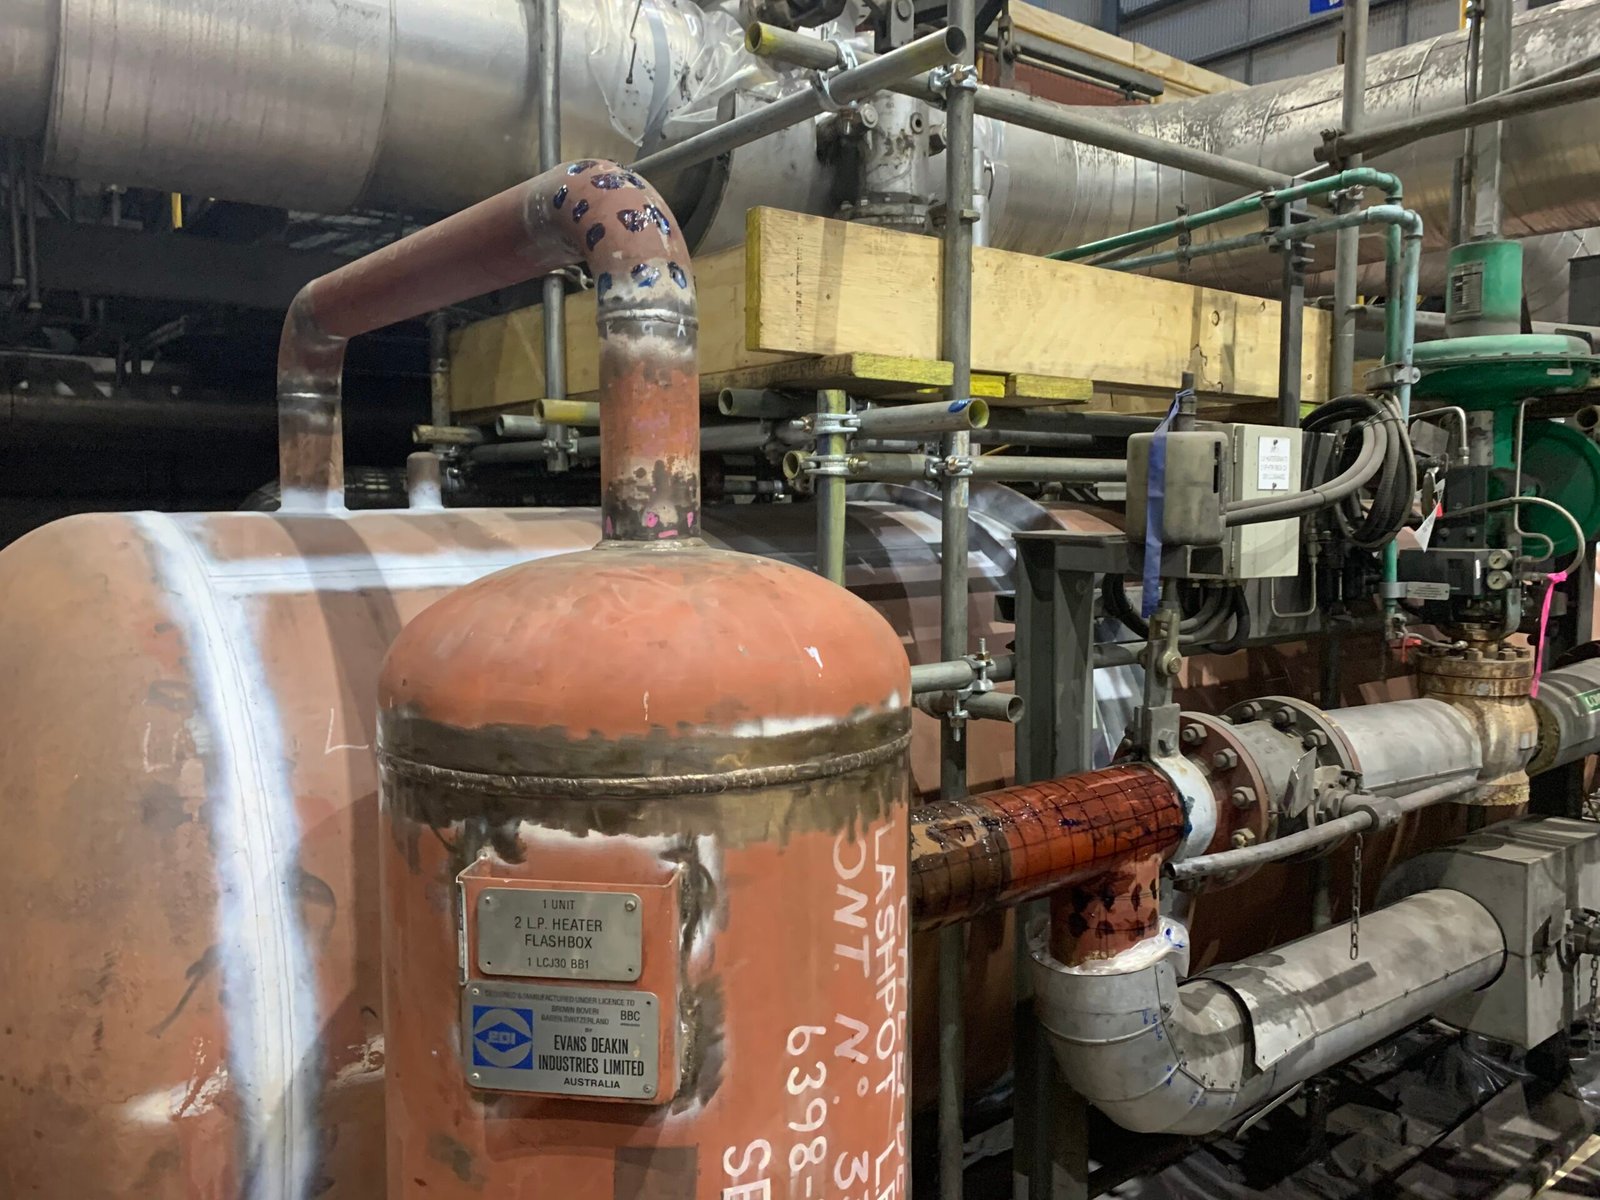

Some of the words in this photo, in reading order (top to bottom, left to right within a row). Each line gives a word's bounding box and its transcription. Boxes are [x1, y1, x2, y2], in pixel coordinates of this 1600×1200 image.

[542, 899, 548, 910] 1
[551, 899, 576, 910] UNIT
[514, 916, 522, 929] 2
[552, 918, 603, 932] HEATER
[525, 933, 593, 949] FLASHBOX
[527, 957, 532, 967] 1
[536, 957, 567, 969] LCJ30
[571, 959, 589, 969] BB1
[620, 1009, 641, 1022] BBC
[554, 1034, 587, 1052] EVANS
[591, 1037, 629, 1054] DEAKIN
[538, 1054, 599, 1074] INDUSTRIES
[603, 1058, 644, 1076] LIMITED
[563, 1077, 621, 1089] AUSTRALIA
